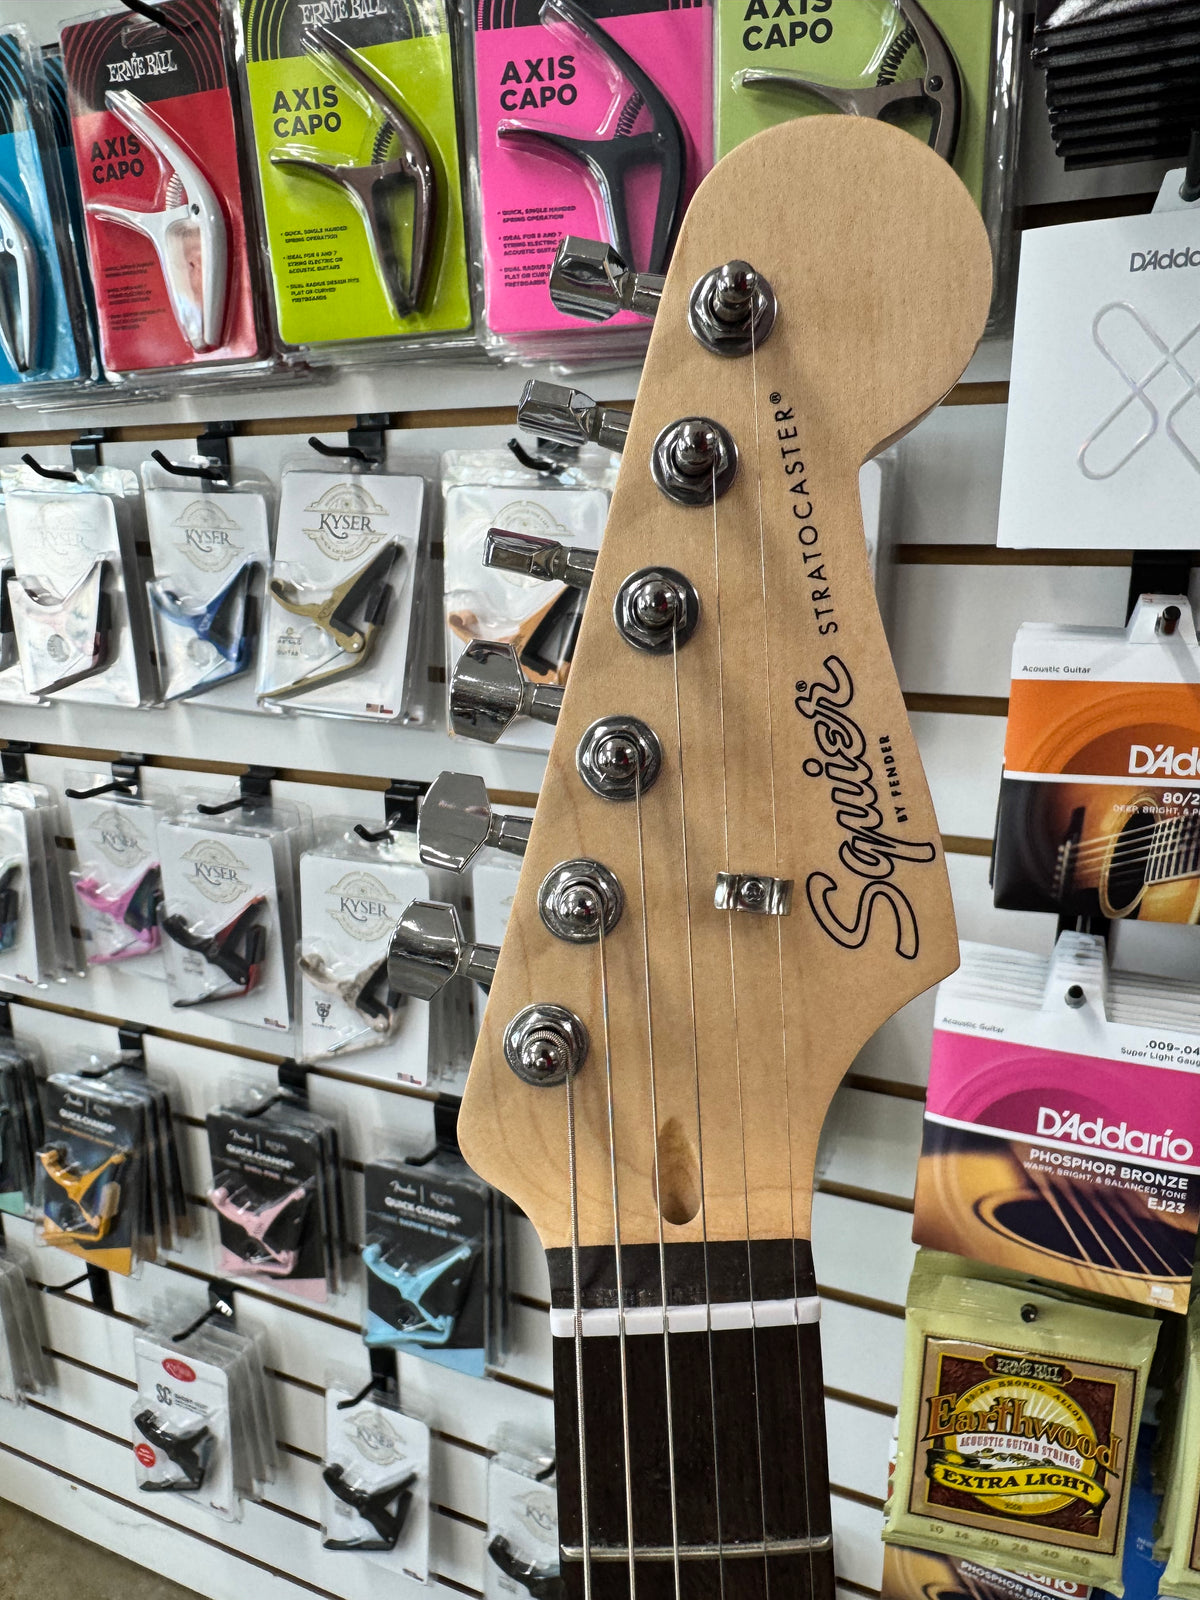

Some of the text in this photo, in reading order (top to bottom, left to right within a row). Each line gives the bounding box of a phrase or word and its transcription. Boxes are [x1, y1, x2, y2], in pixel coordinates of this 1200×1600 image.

[743, 18, 833, 51] CAPO
[106, 49, 178, 82] ERNIE BALL
[500, 55, 576, 85] AXIS
[272, 84, 338, 114] AXIS
[500, 83, 577, 111] CAPO
[273, 111, 342, 138] CAPO
[90, 134, 140, 162] AXIS
[92, 158, 144, 184] CAPO
[185, 528, 234, 552] KYSER
[318, 513, 376, 539] KYSER
[1022, 665, 1091, 674] Acoustic Guitar
[1128, 744, 1200, 776] D'Ad
[879, 735, 909, 823] BY FENDER
[194, 862, 241, 885] KYSER
[340, 897, 389, 922] KYSER
[1121, 1047, 1147, 1057] Super
[1150, 1052, 1174, 1062] Light
[1023, 1160, 1055, 1175] WARM,
[1056, 1167, 1093, 1184] BRIGHT,
[1104, 1177, 1158, 1195] BALANCED
[1161, 1188, 1188, 1201] TONE
[1029, 1148, 1189, 1190] PHOSPHOR BRONZE
[1147, 1197, 1186, 1215] EJ23
[998, 1379, 1046, 1392] BRONZE
[1053, 1393, 1084, 1422] ALLOY
[921, 1392, 1124, 1479] Earthwood
[959, 1435, 1084, 1469] ACOUSTIC GUITAR STRINGS
[942, 1468, 1095, 1496] EXTRA LIGHT
[980, 1536, 999, 1547] 20
[961, 1560, 1023, 1592] PHOSPHOR
[1025, 1588, 1059, 1600] BRO
